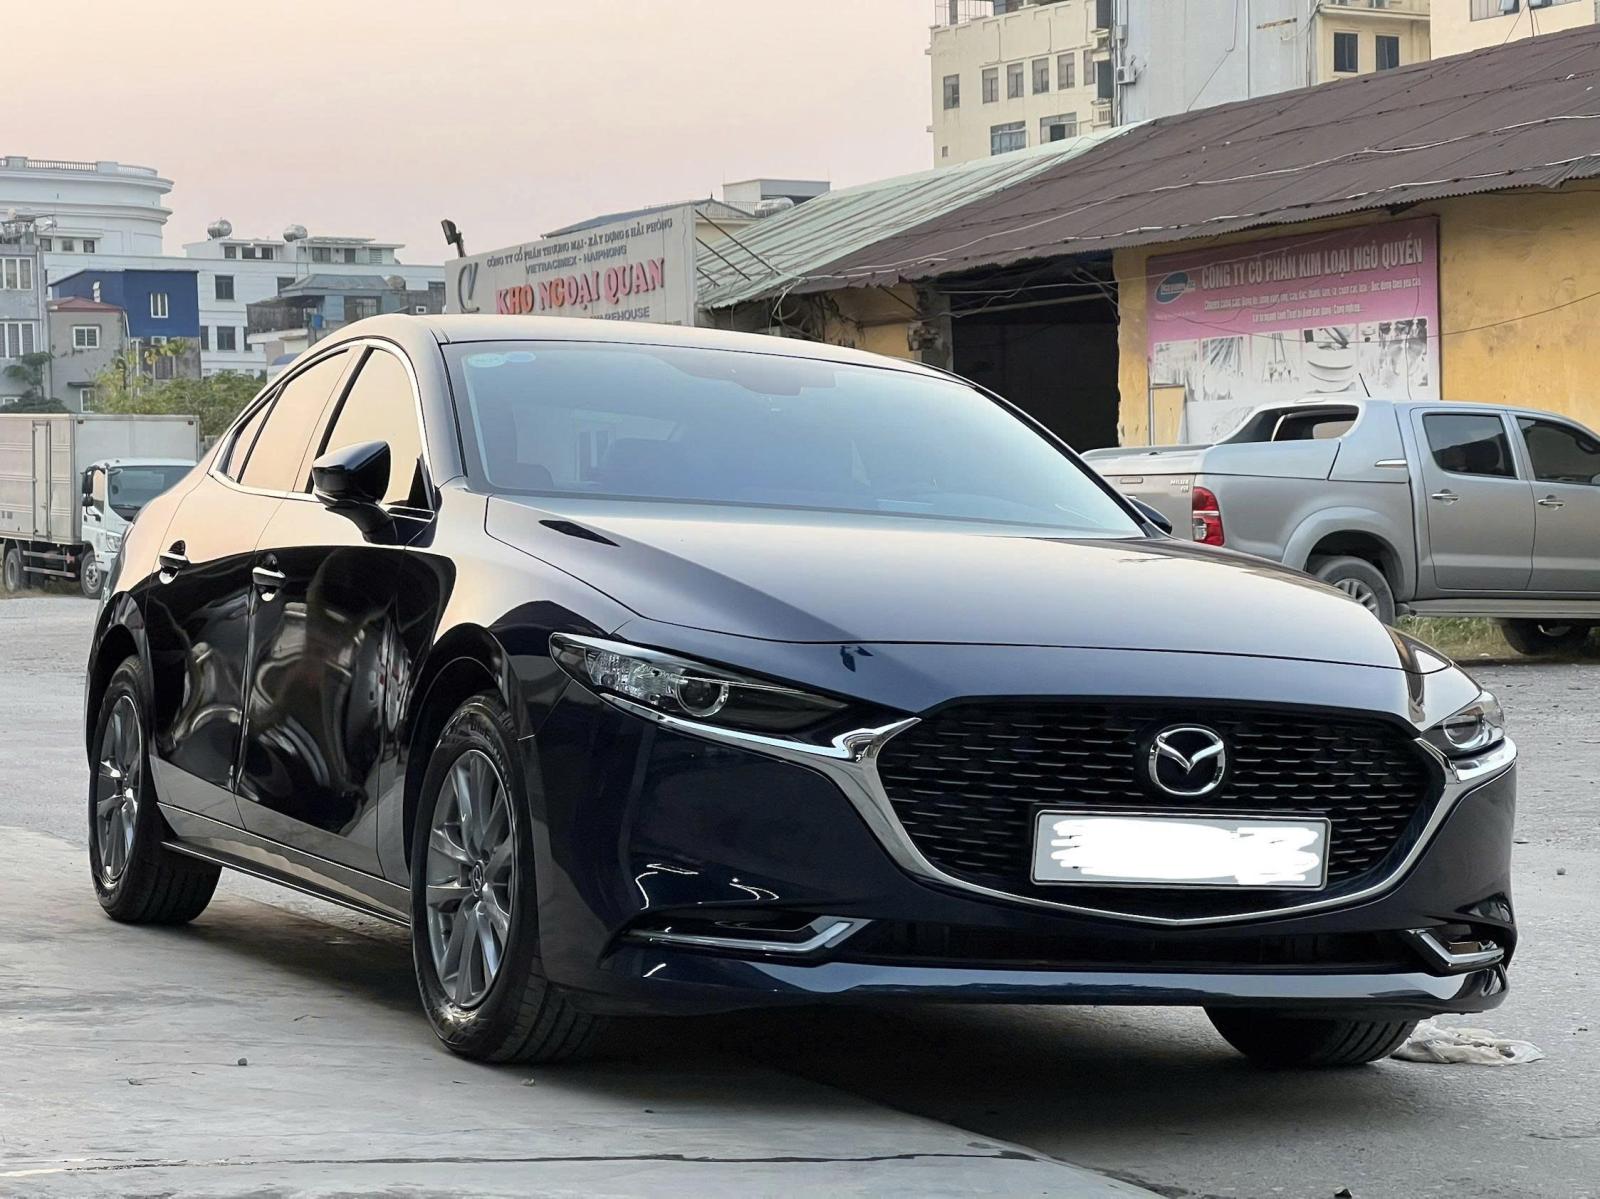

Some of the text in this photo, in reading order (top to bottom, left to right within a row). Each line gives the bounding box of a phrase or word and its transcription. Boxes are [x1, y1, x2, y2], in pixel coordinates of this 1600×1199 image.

[496, 283, 534, 315] KHO
[604, 257, 664, 305] QUAN
[1233, 263, 1245, 286] TY
[1300, 253, 1320, 278] KIM
